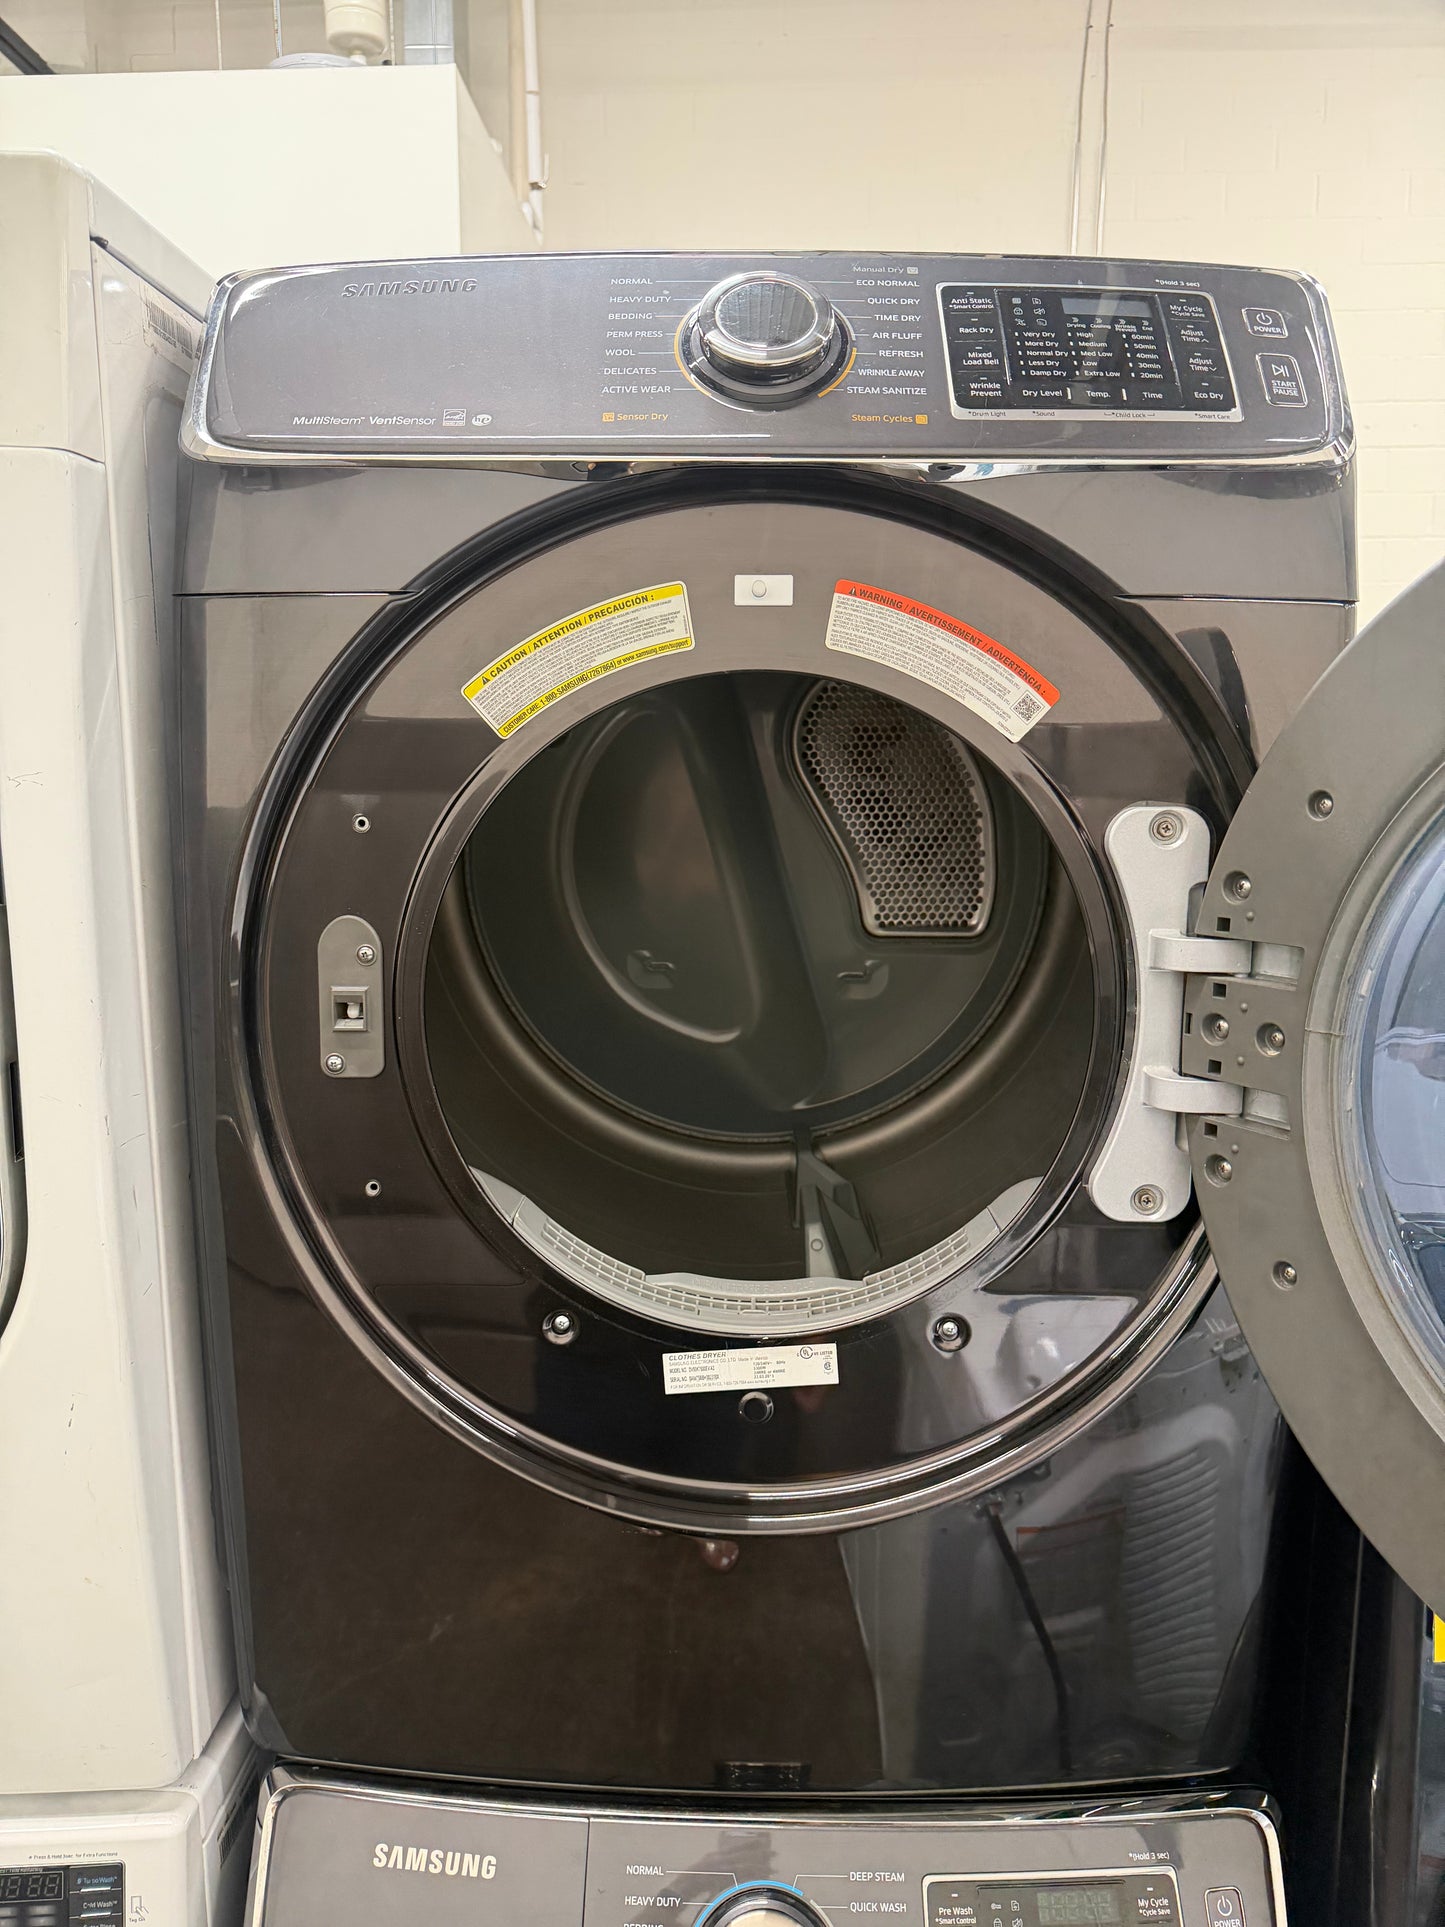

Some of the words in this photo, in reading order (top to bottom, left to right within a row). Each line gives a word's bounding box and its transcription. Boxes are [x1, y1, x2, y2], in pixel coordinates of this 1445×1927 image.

[342, 279, 478, 298] SAMSUNG
[1253, 326, 1282, 334] POWER
[1189, 358, 1213, 366] Adjust
[1271, 380, 1296, 388] START
[640, 385, 670, 393] WEAR
[846, 386, 880, 394] STEAM
[882, 387, 927, 395] SANITIZE
[1273, 388, 1298, 397] PAUSE
[1086, 390, 1111, 398] Temp.
[369, 415, 436, 425] VentSensor
[651, 413, 668, 422] Dry
[852, 414, 880, 422] Steam
[883, 415, 913, 423] Cycles
[490, 649, 527, 678] CAUTION
[533, 619, 582, 650] ATTENTION
[588, 595, 649, 622] PRECAUCIÓN
[860, 588, 903, 609] WARNING
[909, 606, 982, 646] AVERTISSEMENT
[986, 646, 1042, 691] ADVERTENCIA
[503, 712, 528, 733] CUSTOMER
[1151, 1852, 1156, 1860] 3
[1157, 1851, 1169, 1860] sec)
[373, 1843, 497, 1879] SAMSUNG
[626, 1865, 664, 1875] NORMAL
[849, 1871, 873, 1881] DEEP
[875, 1872, 905, 1882] STEAM
[624, 1895, 655, 1906] HEAVY
[656, 1897, 681, 1907] DUTY
[1138, 1898, 1148, 1909] My
[1150, 1897, 1169, 1908] Cycle
[850, 1902, 878, 1913] QUICK
[880, 1903, 907, 1913] WASH
[939, 1907, 951, 1916] Pre
[953, 1906, 973, 1915] Wash
[1158, 1908, 1171, 1916] Save
[1214, 1919, 1241, 1927] POWER
